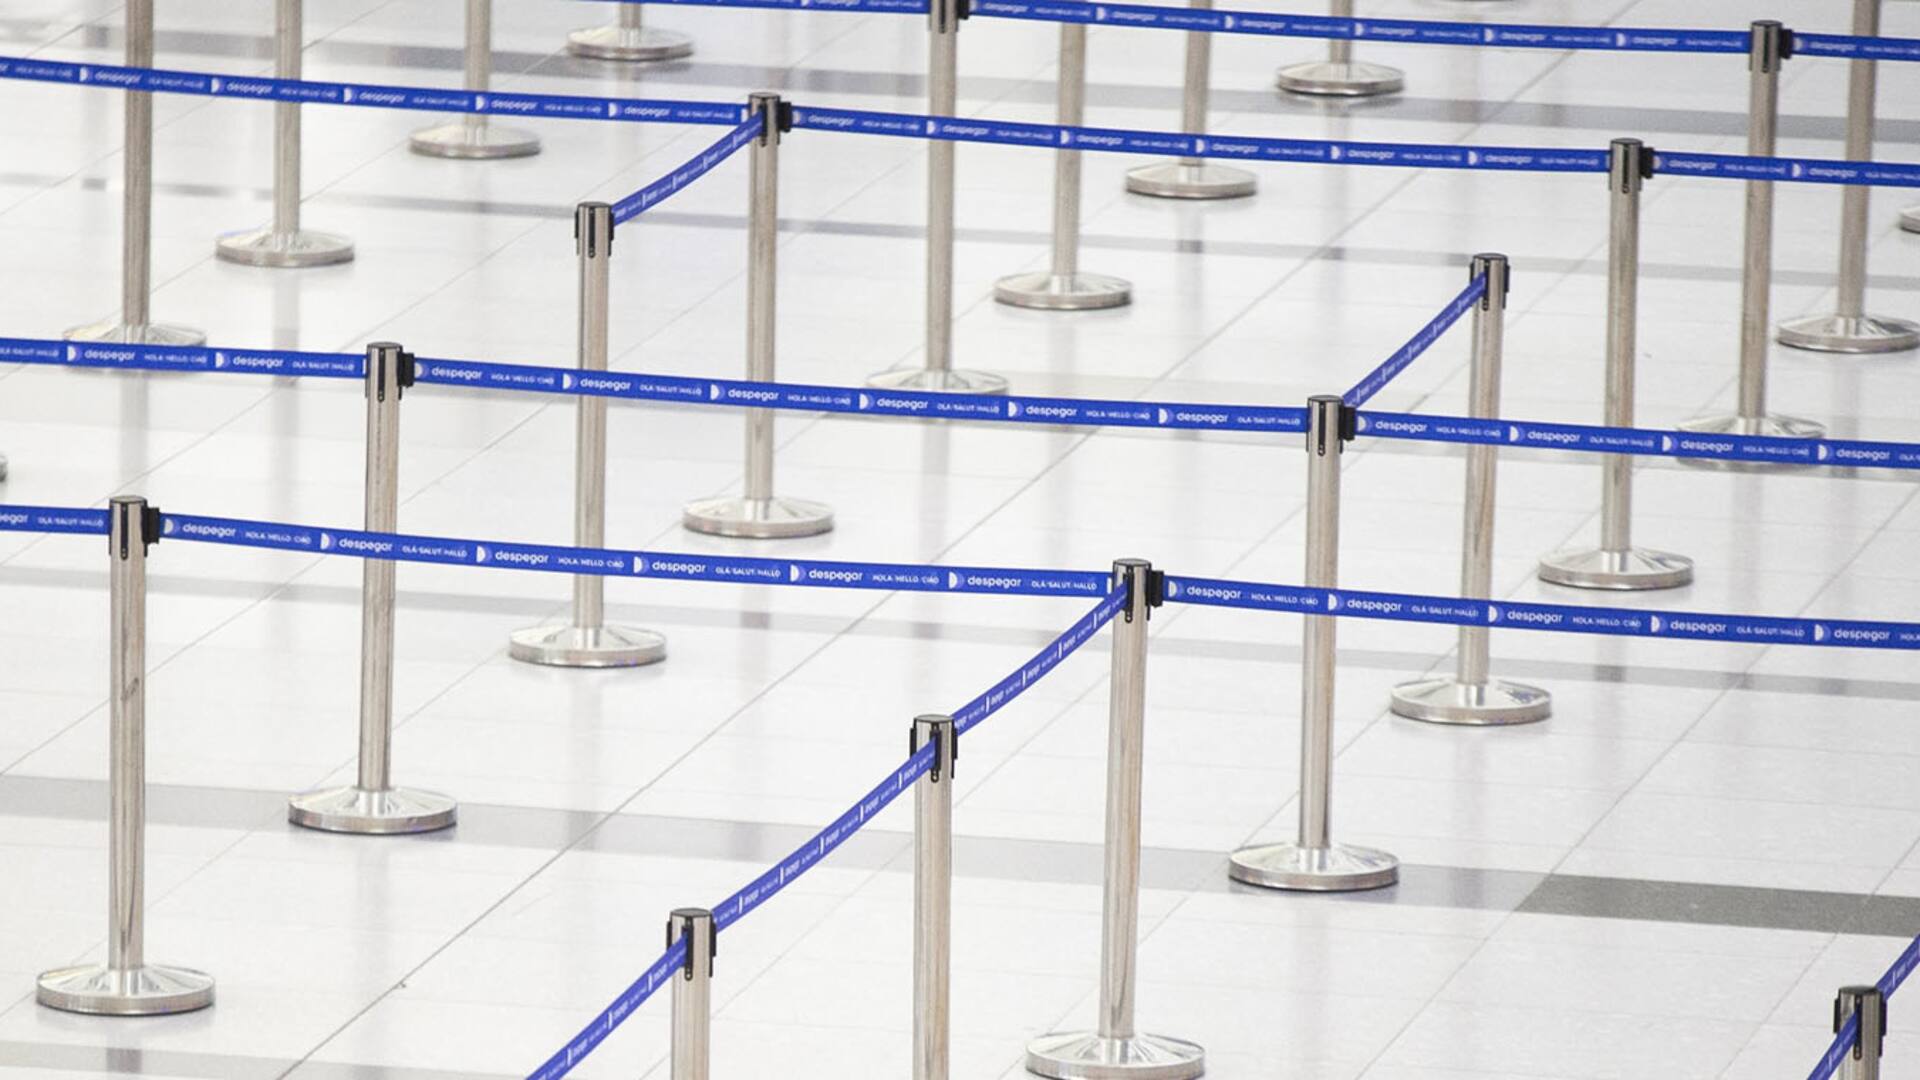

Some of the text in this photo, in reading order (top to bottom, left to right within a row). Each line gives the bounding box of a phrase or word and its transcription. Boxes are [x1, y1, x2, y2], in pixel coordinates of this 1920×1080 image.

[85, 349, 136, 361] despegar
[233, 355, 284, 368] despegar
[432, 366, 483, 380] despegar
[580, 377, 632, 391] despegar
[728, 388, 779, 401] despegar
[877, 397, 929, 410] despegar
[1026, 405, 1078, 418] despegar
[1177, 412, 1228, 424] despegar
[1375, 420, 1428, 433] despegar
[1527, 430, 1581, 443] despegar
[1681, 439, 1734, 453] despegar
[1836, 448, 1891, 461] despegar
[182, 523, 237, 537] despegar
[339, 538, 393, 552] despegar
[495, 550, 549, 564] despegar
[652, 560, 706, 574] despegar
[809, 568, 863, 582] despegar
[968, 575, 1022, 588] despegar
[1187, 585, 1242, 600] despegar
[1347, 598, 1402, 613] despegar
[1507, 610, 1563, 624] despegar
[1670, 619, 1727, 633] despegar
[1834, 628, 1890, 641] despegar
